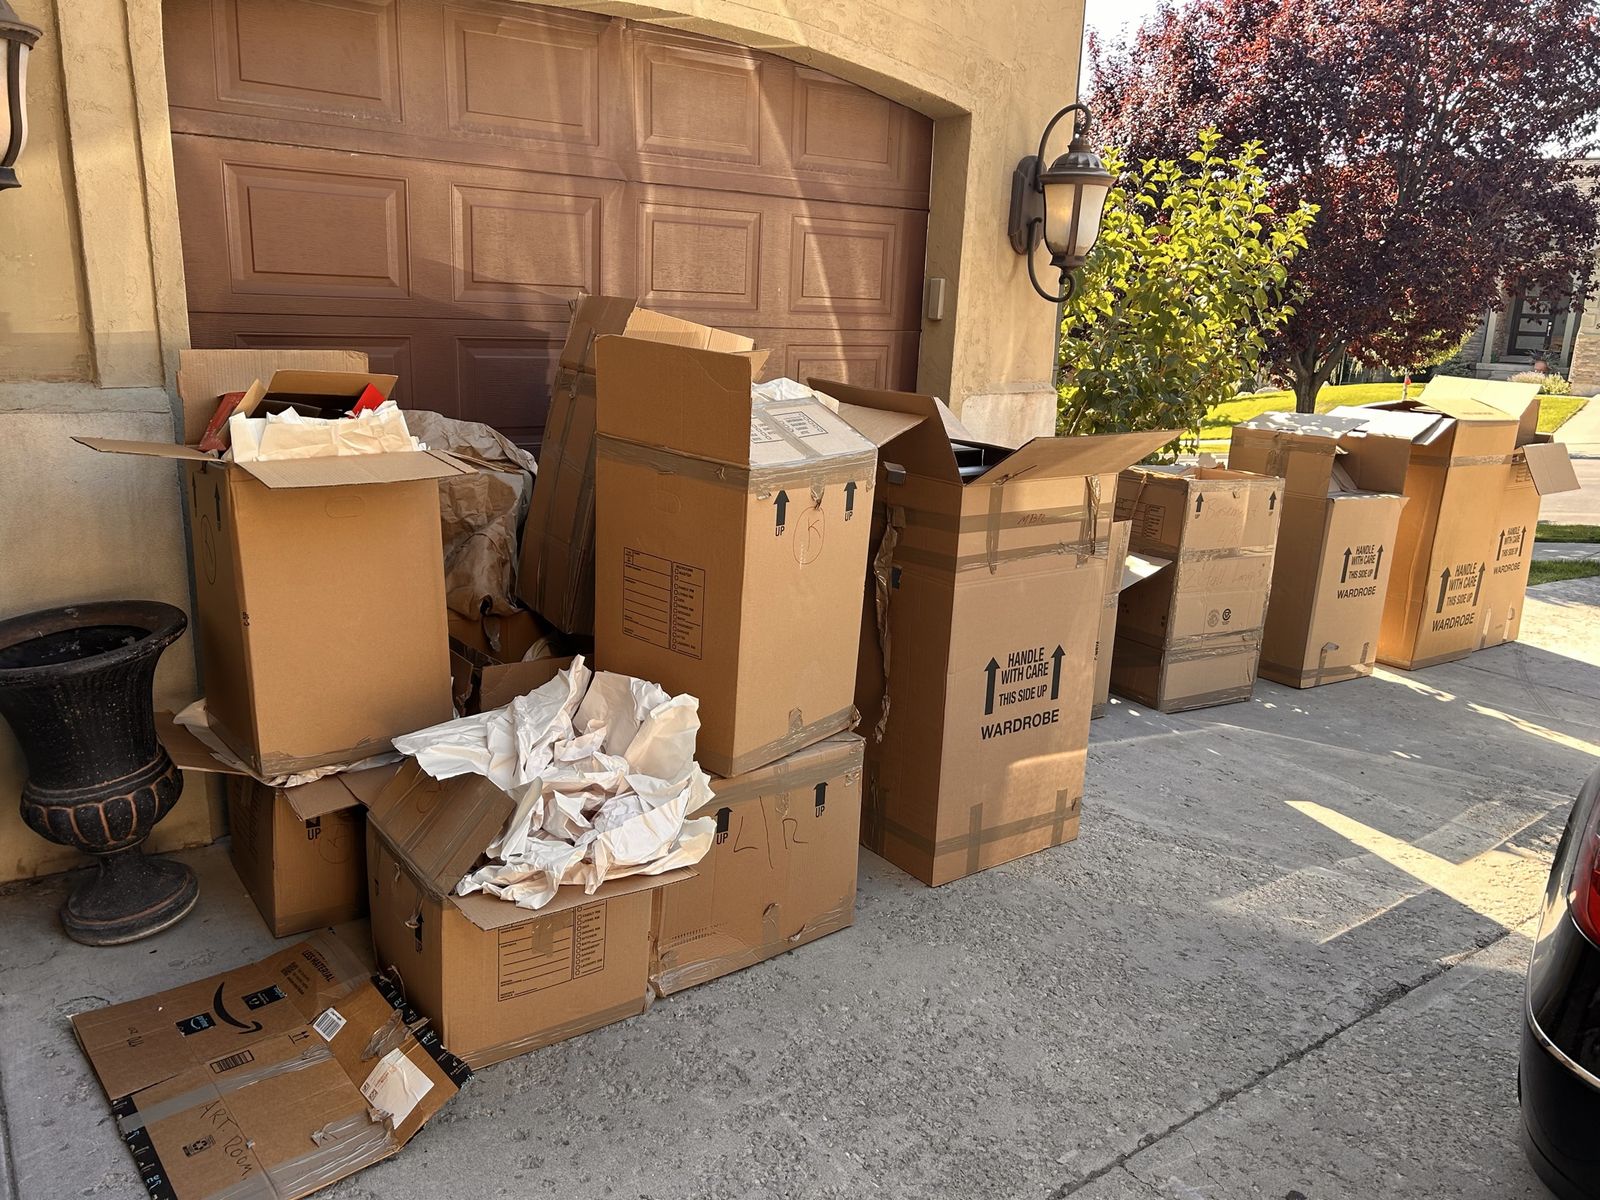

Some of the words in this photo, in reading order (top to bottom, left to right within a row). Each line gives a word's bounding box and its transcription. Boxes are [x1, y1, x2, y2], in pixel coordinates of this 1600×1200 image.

[845, 511, 853, 521] UP
[775, 526, 784, 536] UP
[1507, 526, 1520, 535] HANDLE
[1504, 536, 1513, 545] WITH
[1512, 534, 1521, 543] CARE
[1356, 544, 1374, 554] HANDLE
[1351, 556, 1363, 566] WITH
[1364, 554, 1376, 564] CARE
[1349, 570, 1358, 578] THIS
[1358, 570, 1367, 578] SIDE
[1367, 569, 1373, 577] UP
[1455, 562, 1477, 575] HANDLE
[1493, 562, 1521, 574] WARDROBE
[1449, 578, 1463, 591] WITH
[1463, 575, 1477, 589] CARE
[1337, 586, 1376, 599] WARDROBE
[1447, 596, 1456, 606] THIS
[1457, 595, 1466, 604] SIDE
[1466, 592, 1473, 602] UP
[1432, 612, 1475, 632] WARDROBE
[1008, 647, 1045, 668] HANDLE
[1002, 665, 1024, 684] WITH
[1025, 662, 1049, 680] CARE
[999, 691, 1016, 706] THIS
[1017, 688, 1035, 703] SIDE
[1036, 684, 1048, 698] UP
[981, 709, 1060, 740] WARDROBE
[815, 806, 825, 818] UP
[307, 828, 321, 840] UP
[716, 832, 728, 845] UP
[312, 957, 335, 982] MATERIAL
